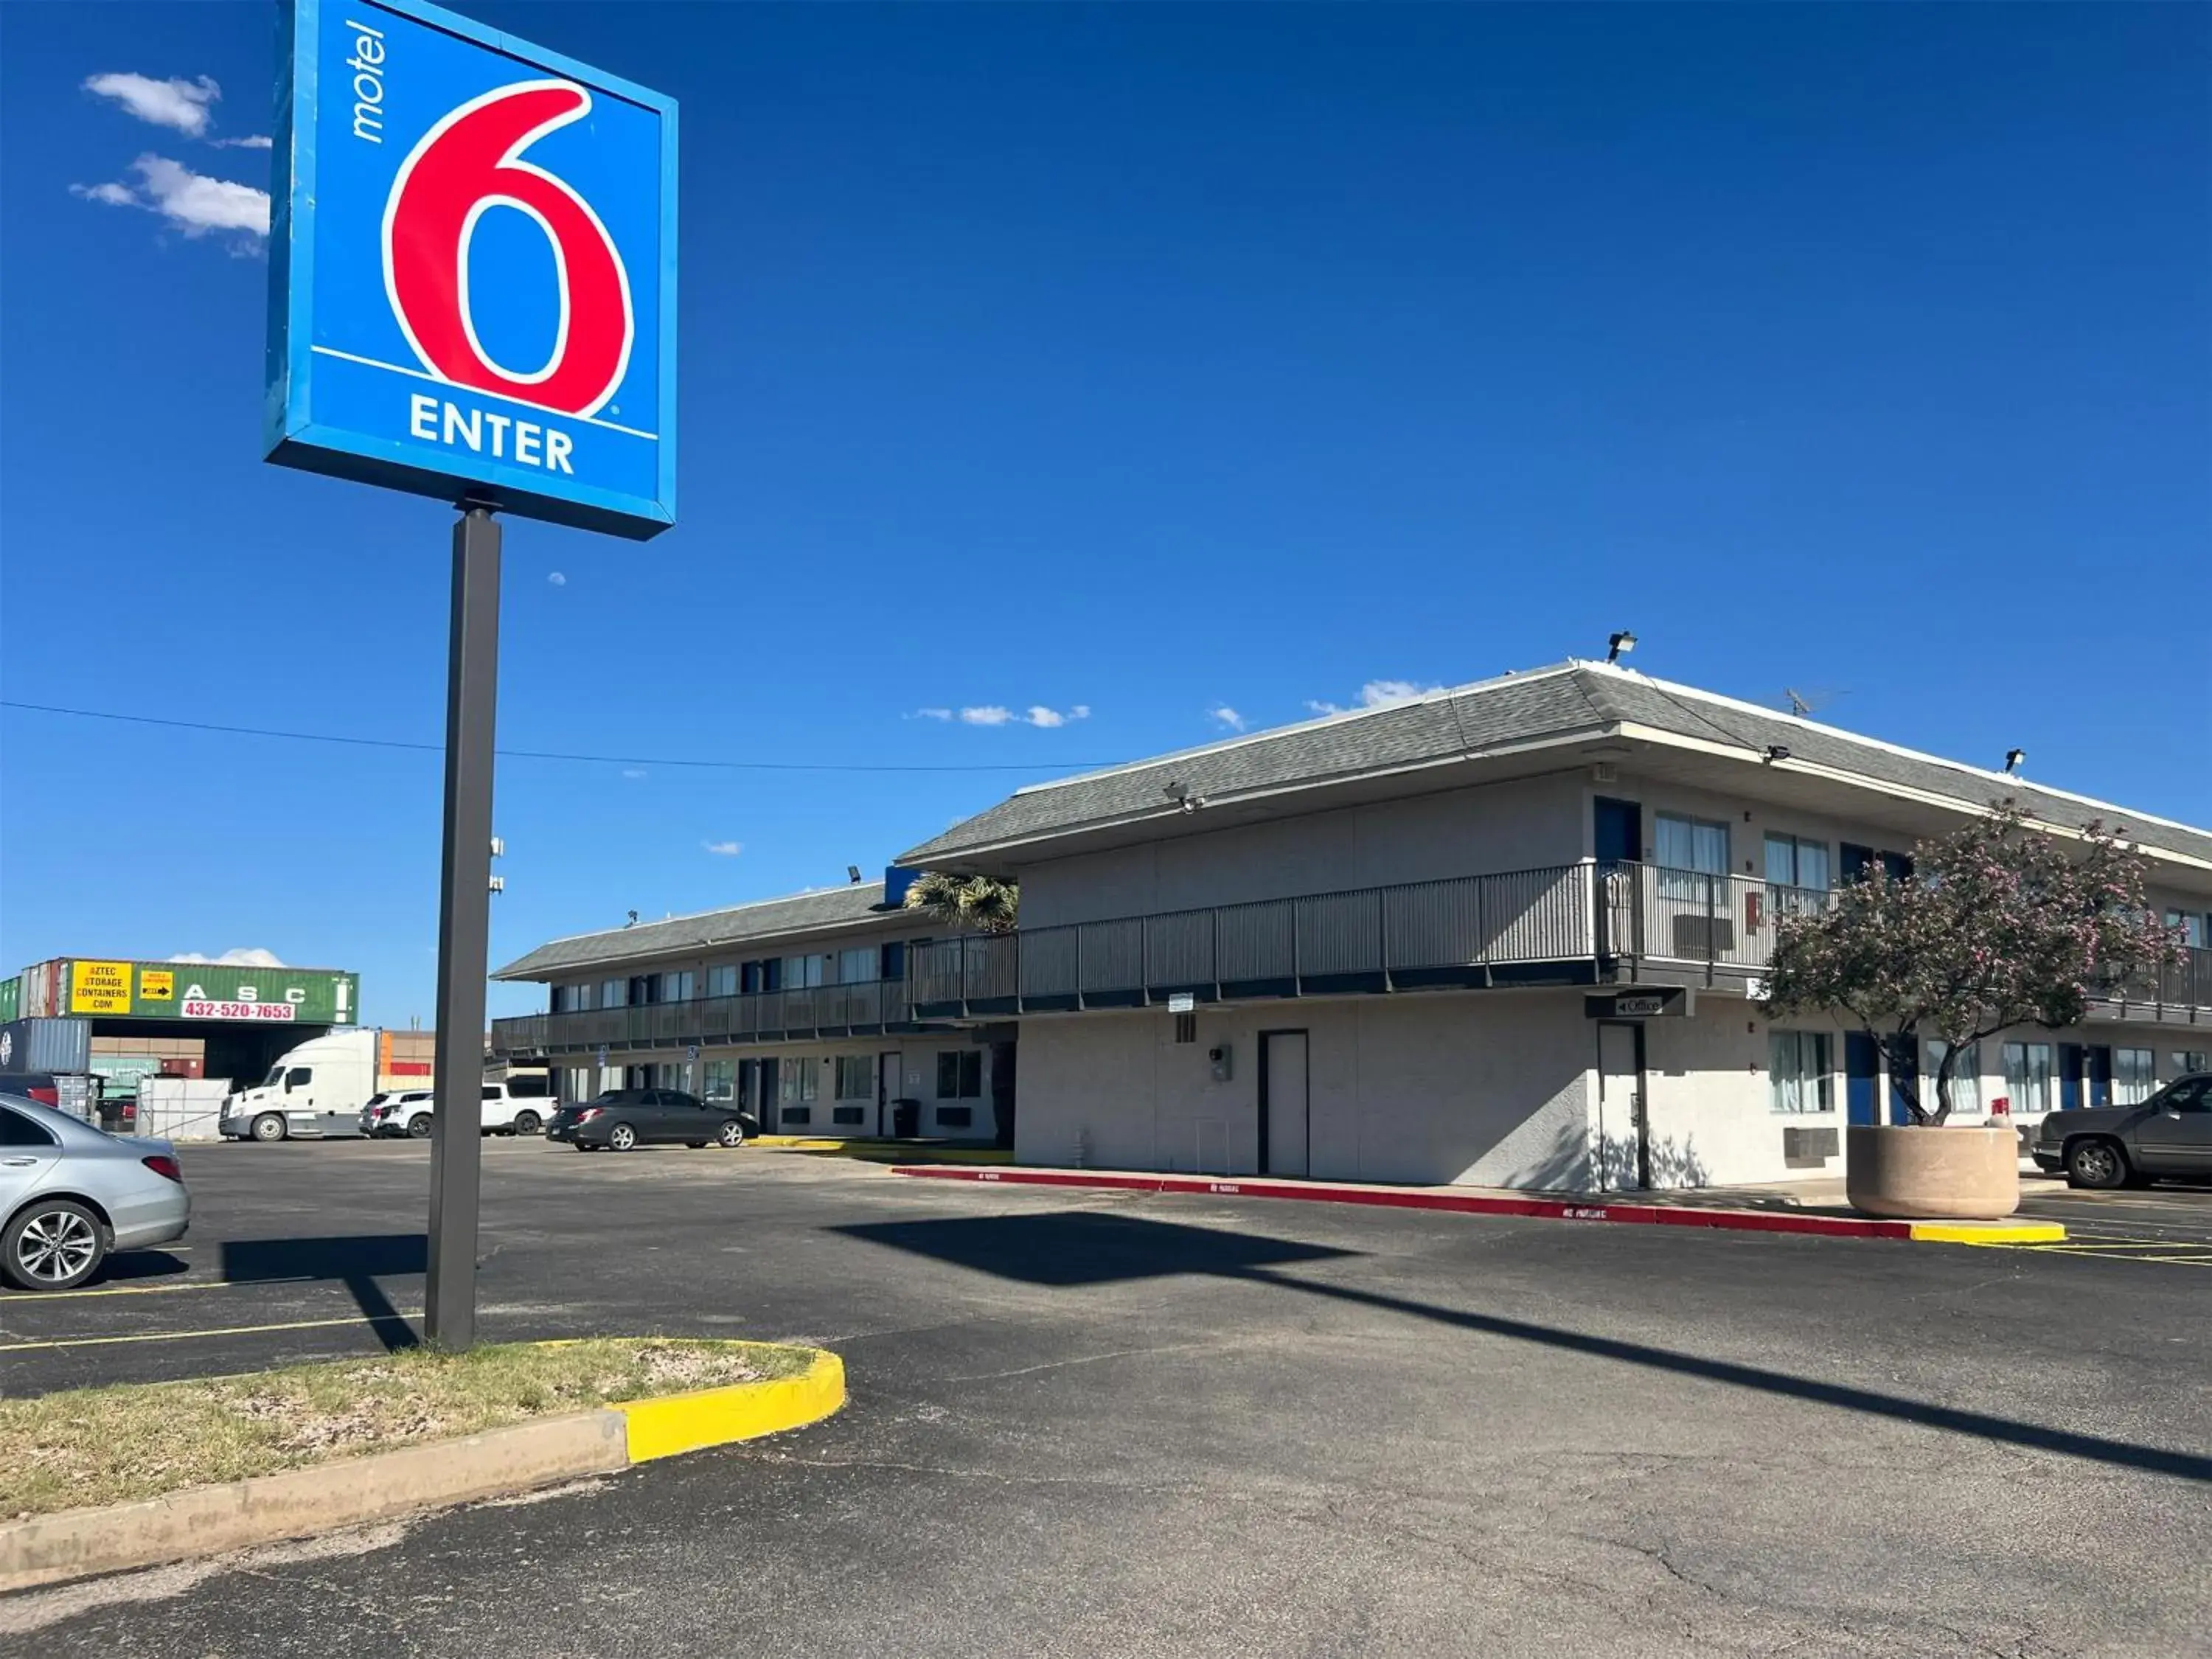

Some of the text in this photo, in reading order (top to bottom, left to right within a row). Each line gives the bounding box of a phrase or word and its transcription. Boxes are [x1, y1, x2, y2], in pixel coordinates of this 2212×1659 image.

[346, 19, 386, 144] motel
[381, 79, 634, 420] 6
[411, 393, 574, 475] ENTER
[89, 967, 116, 975] AZTEC
[85, 977, 122, 987] STORAGE
[76, 988, 128, 998] CONTAINERS
[185, 1002, 292, 1018] 432-520-7653
[1628, 999, 1660, 1012] Office
